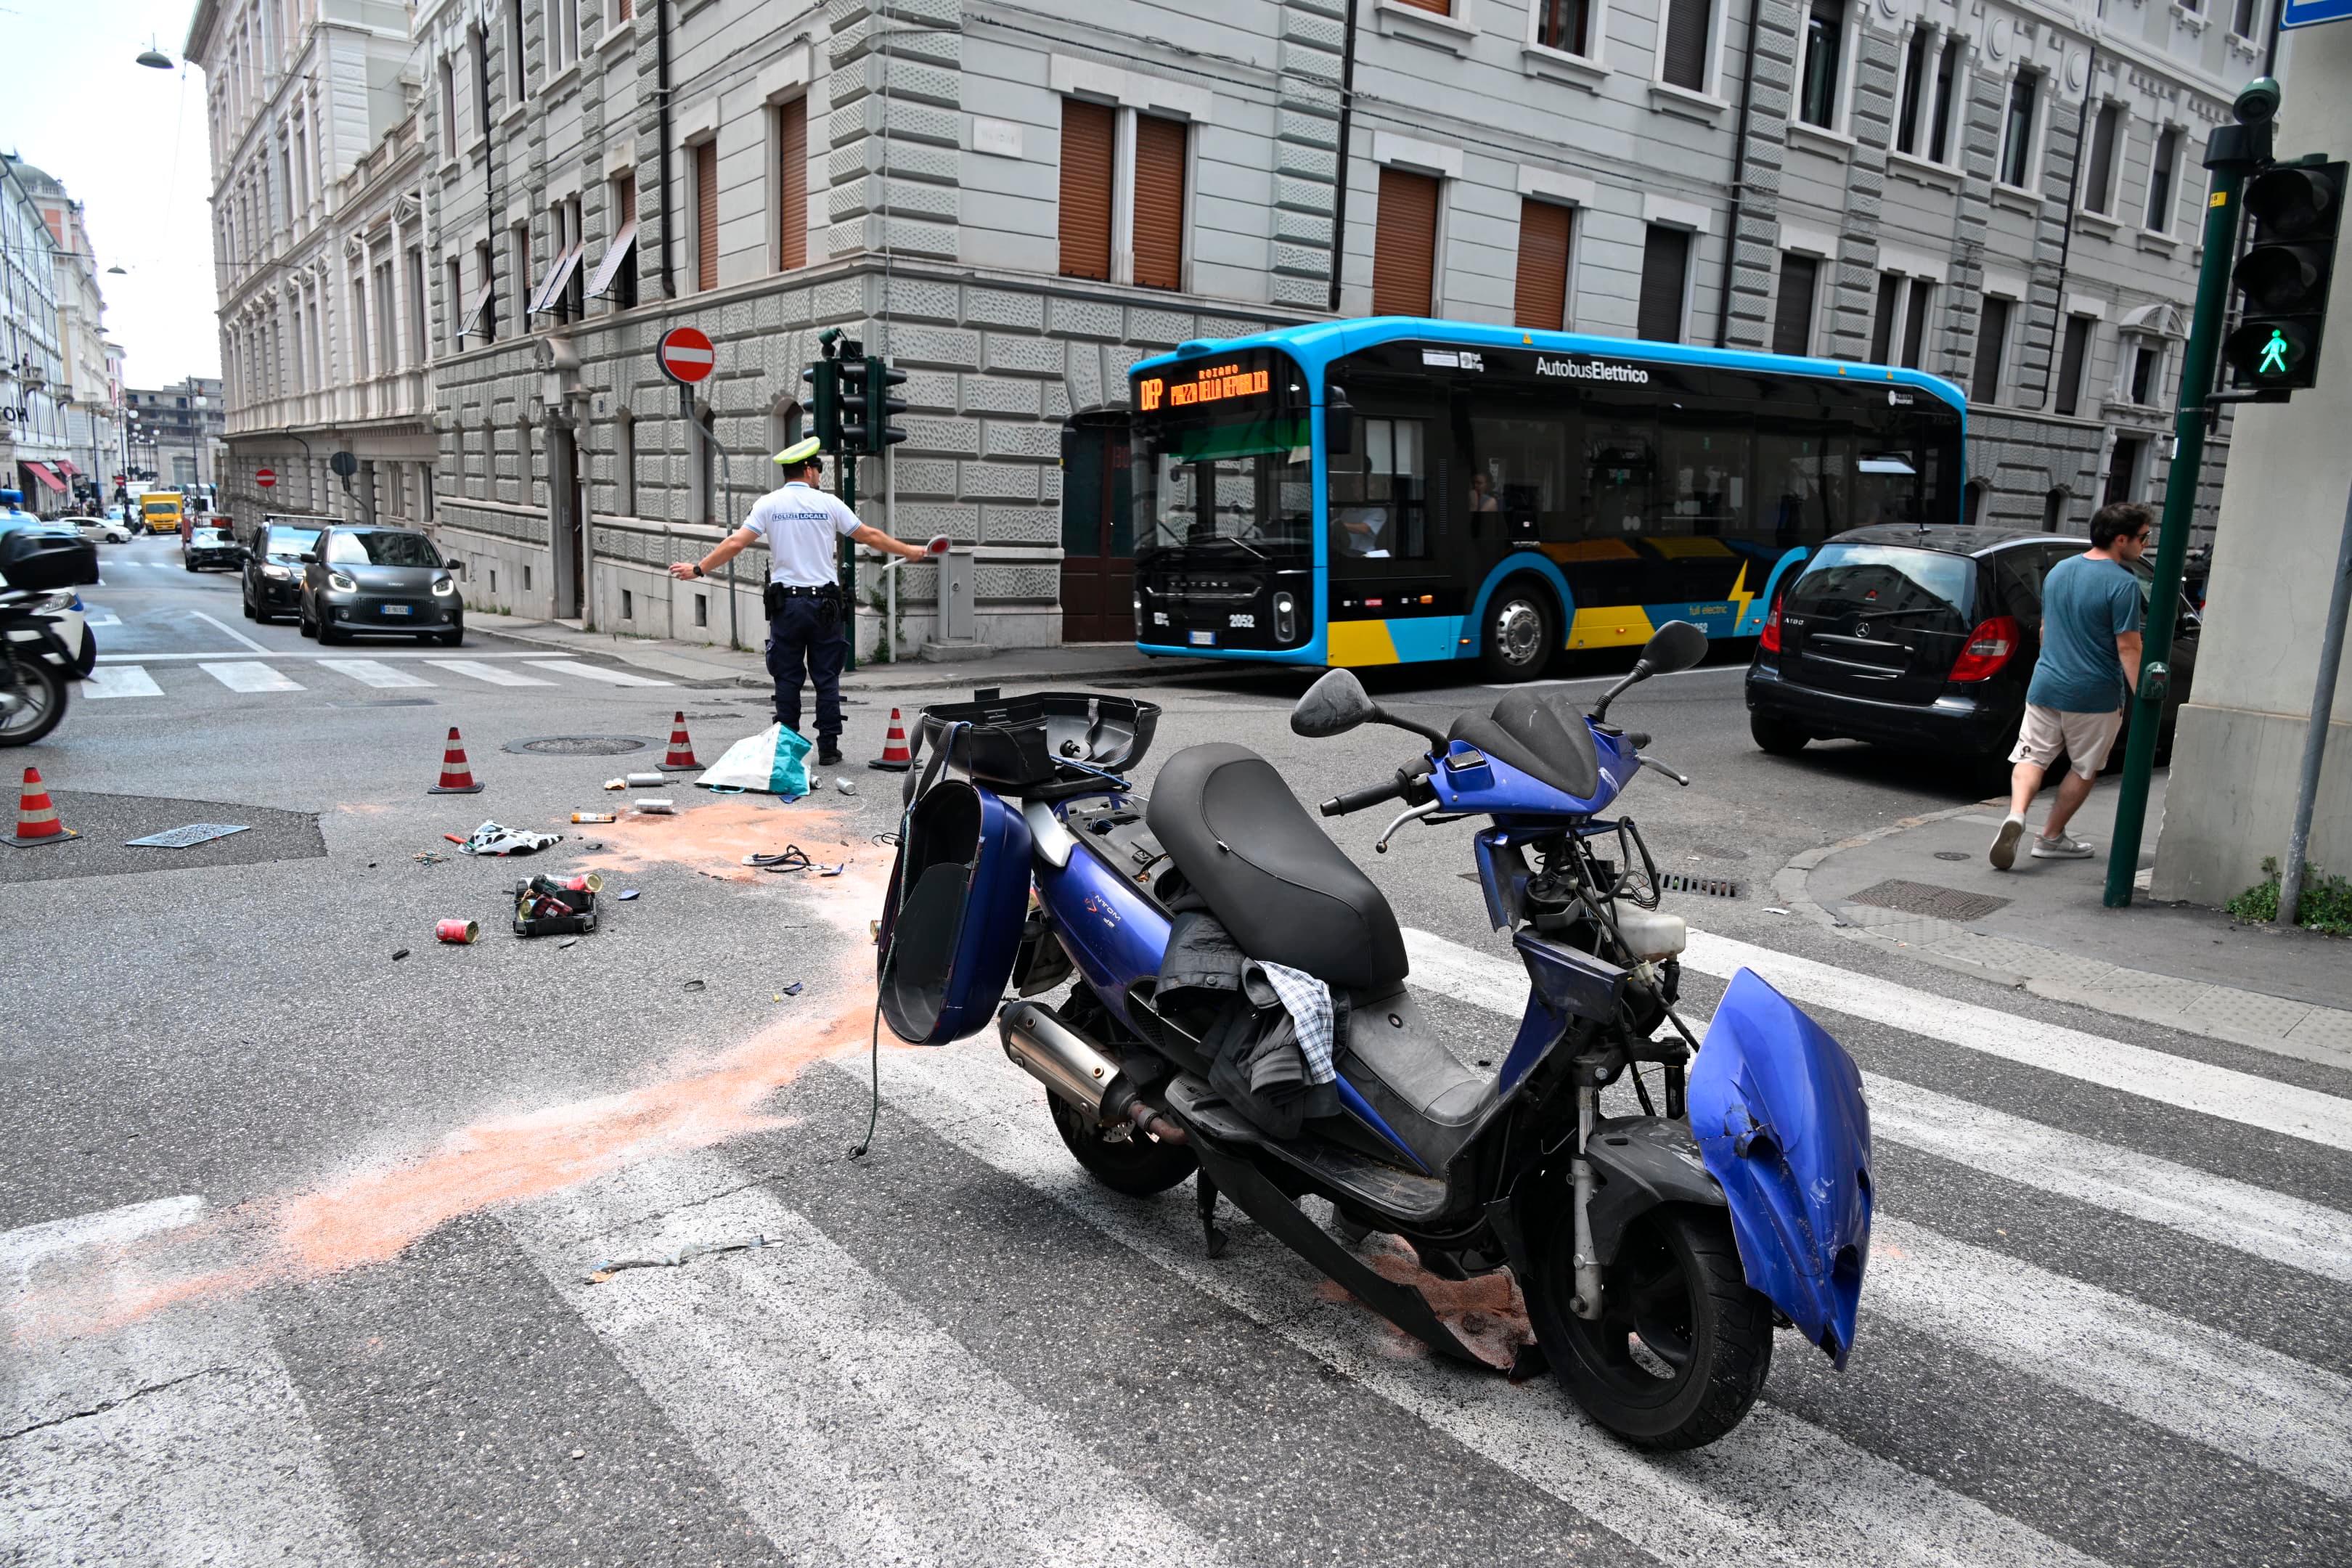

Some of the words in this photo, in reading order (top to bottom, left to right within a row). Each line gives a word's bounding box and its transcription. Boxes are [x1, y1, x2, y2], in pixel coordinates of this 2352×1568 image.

[1199, 364, 1238, 380] ROIANO
[1535, 356, 1649, 383] AutobusElettrico
[1141, 378, 1163, 411] DEP
[1689, 605, 1700, 616] full
[1702, 605, 1728, 615] electric
[1229, 614, 1255, 628] 2052
